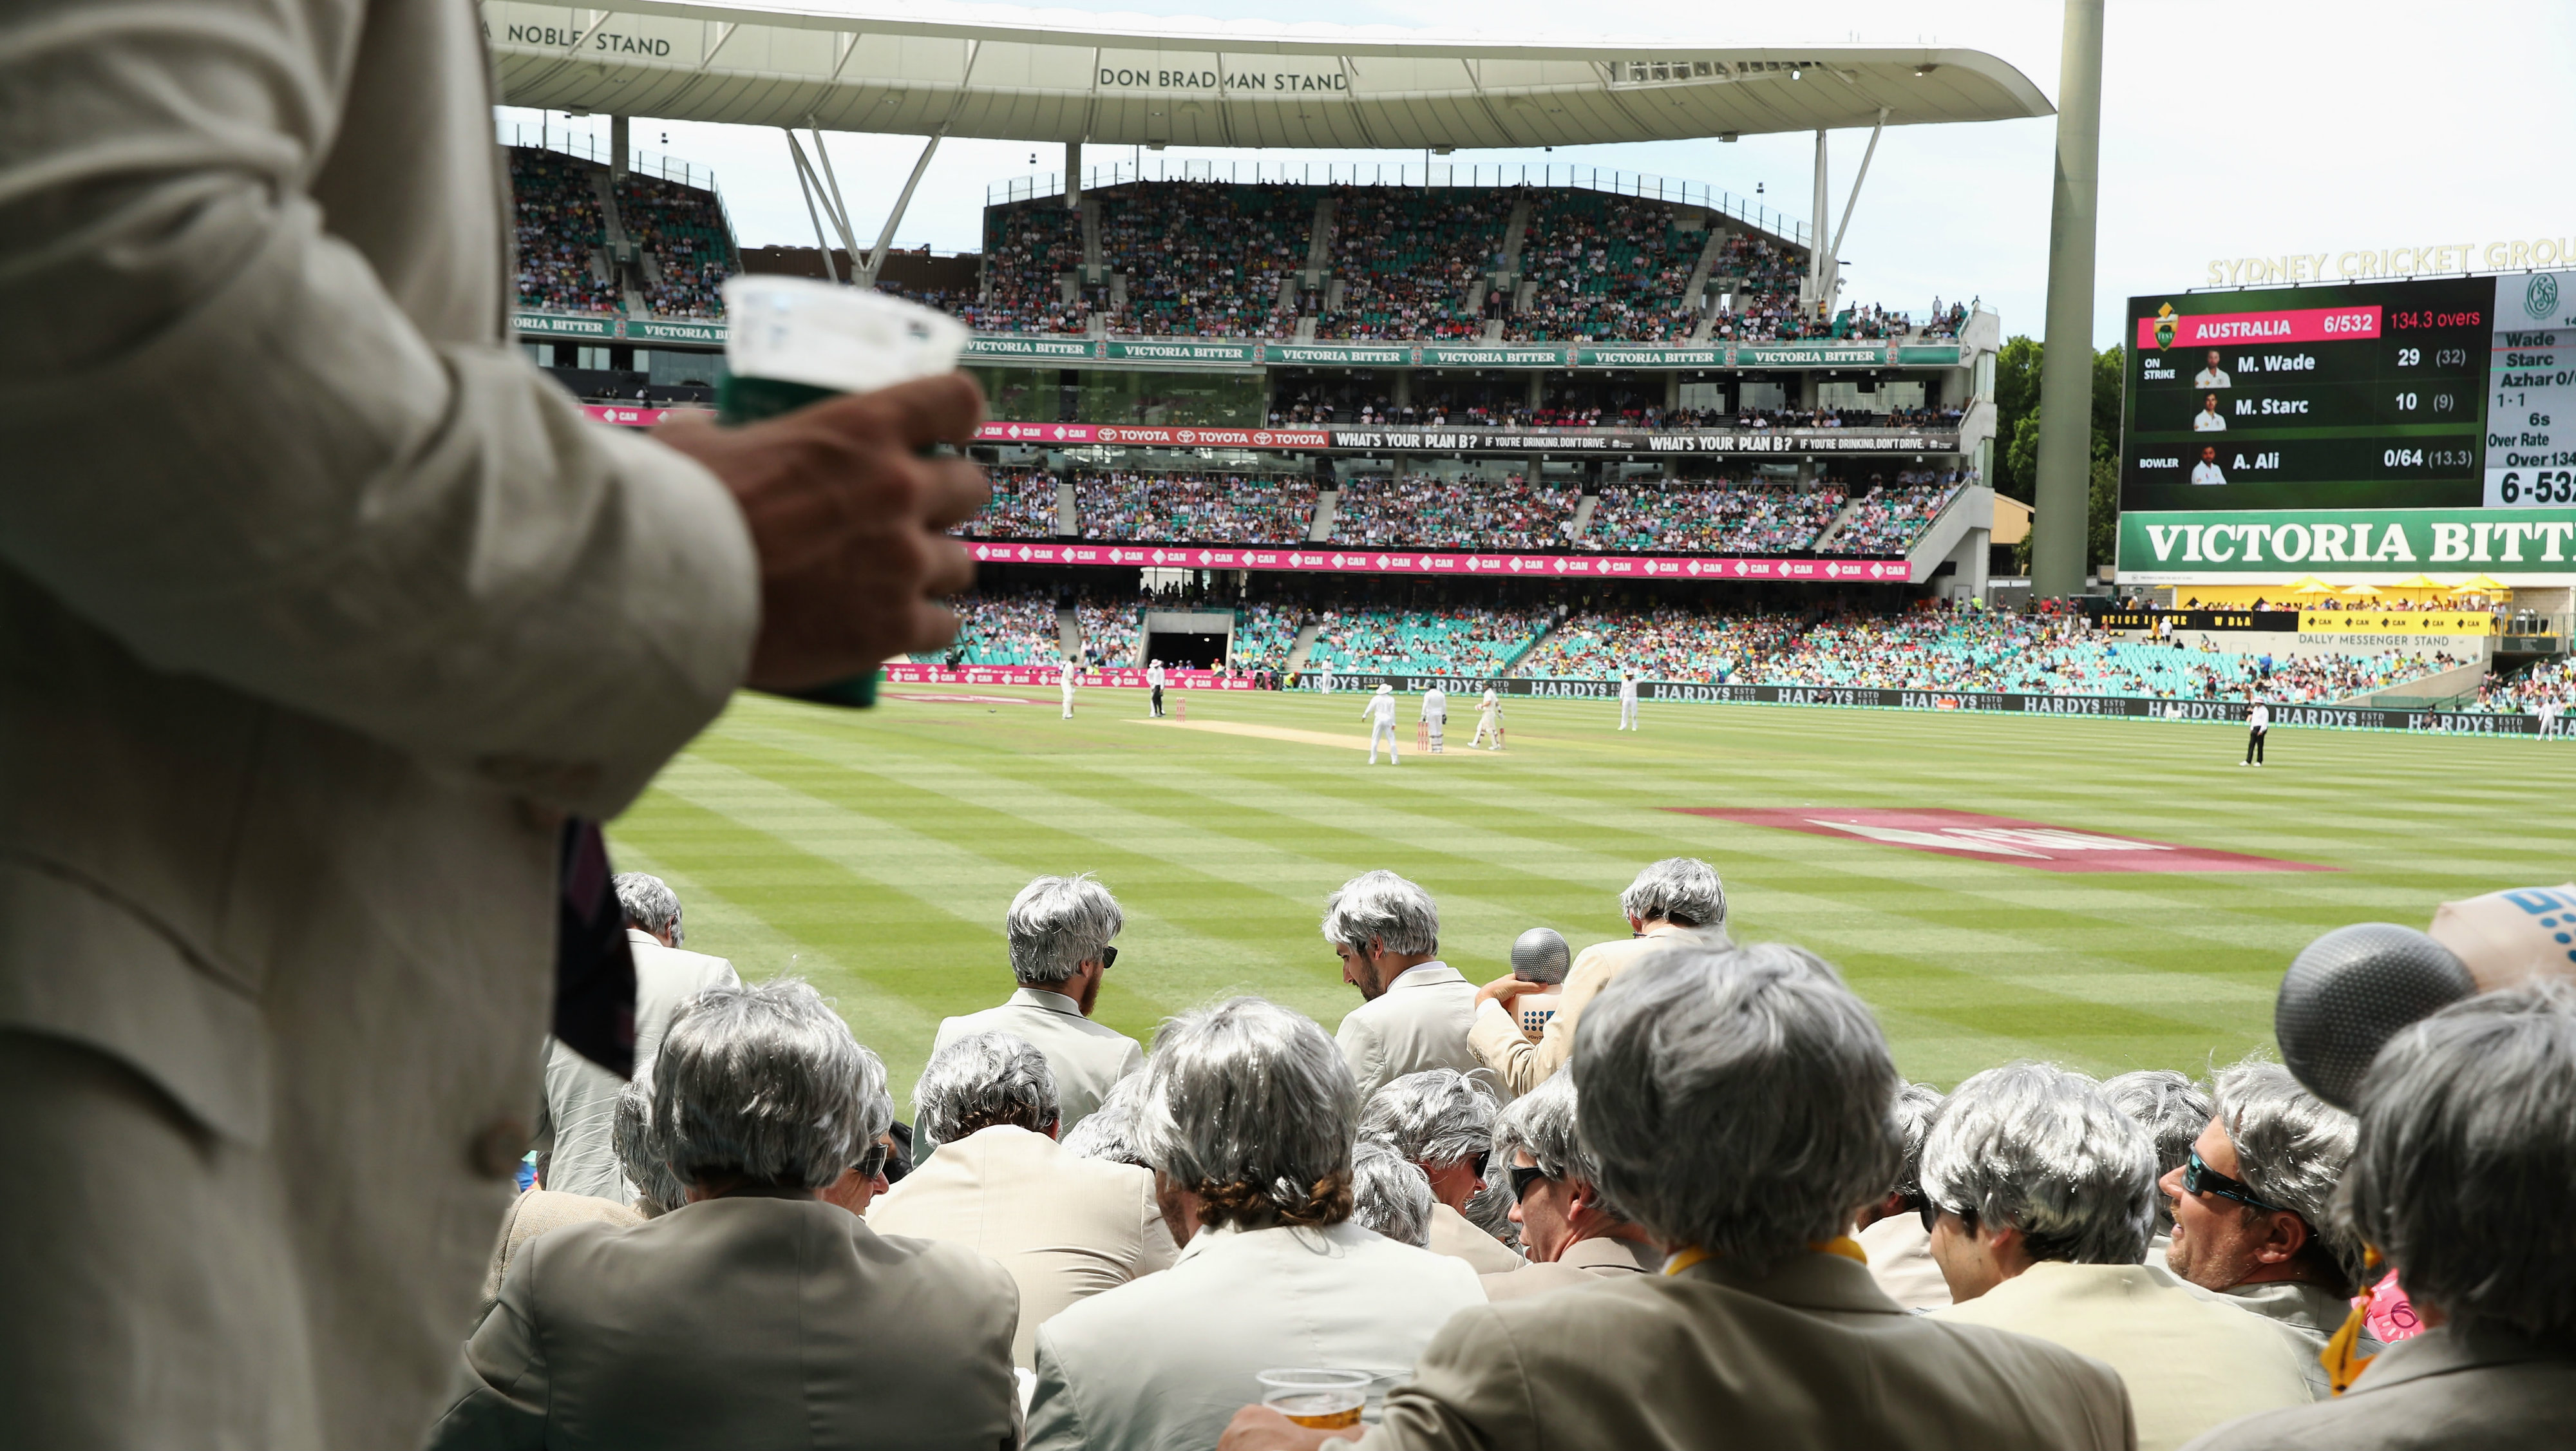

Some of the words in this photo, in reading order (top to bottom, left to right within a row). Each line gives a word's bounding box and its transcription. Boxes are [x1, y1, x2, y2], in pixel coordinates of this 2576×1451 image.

[509, 24, 583, 48] NOBLE
[596, 33, 670, 57] STAND
[1101, 68, 1150, 86] DON
[1160, 70, 1265, 90] BRADMAN
[1274, 73, 1347, 91] STAND
[2207, 253, 2328, 283] SYDNEY
[2337, 243, 2475, 276] CRICKET
[552, 319, 603, 333] BITTER
[2196, 320, 2291, 339] AUSTRALIA
[2324, 314, 2373, 332] 6/532
[2391, 310, 2433, 329] 134.3
[2438, 312, 2480, 327] overs
[644, 325, 712, 340] VICTORIA
[2506, 332, 2555, 347] Wade
[967, 341, 1032, 354] VICTORIA
[1035, 343, 1084, 355] BITTER
[1124, 345, 1191, 357] VICTORIA
[1194, 347, 1243, 359] BITTER
[1282, 350, 1348, 361] VICTORIA
[1351, 351, 1400, 362] BITTER
[1437, 352, 1503, 363] VICTORIA
[1506, 352, 1556, 363] BITTER
[1595, 352, 1662, 363] VICTORIA
[1665, 352, 1714, 363] BITTER
[1754, 352, 1822, 362] VICTORIA
[1824, 351, 1875, 361] BITTER
[2238, 356, 2259, 372] M.
[2264, 354, 2316, 372] Wade
[2398, 348, 2421, 366] 29
[2436, 348, 2466, 367] (32)
[2506, 352, 2554, 367] Starc
[2145, 358, 2160, 368] ON
[2144, 369, 2175, 380] STRIKE
[2501, 371, 2553, 388] Azhar
[2556, 370, 2576, 386] 0/
[2235, 399, 2257, 415] M.
[2261, 398, 2309, 415] Starc
[2396, 392, 2418, 411] 10
[2434, 394, 2454, 412] (9)
[619, 412, 638, 421] CAN
[2529, 412, 2551, 426] 6s
[985, 427, 1003, 435] CAN
[1023, 428, 1041, 437] CAN
[1068, 429, 1086, 438] CAN
[1119, 430, 1170, 441] TOYOTA
[1198, 432, 1248, 443] TOYOTA
[1275, 433, 1325, 445] TOYOTA
[1336, 432, 1381, 447] WHAT'S
[1385, 433, 1421, 448] YOUR
[1425, 433, 1455, 448] PLAN
[1459, 434, 1477, 448] B?
[1485, 437, 1493, 447] IF
[1495, 437, 1521, 447] YOU'RE
[1582, 438, 1607, 449] DRIVE.
[2488, 433, 2517, 447] Over
[2521, 432, 2550, 447] Rate
[1649, 436, 1695, 451] WHAT'S
[1699, 437, 1734, 451] YOUR
[1739, 437, 1770, 451] PLAN
[1773, 437, 1793, 451] B?
[1800, 439, 1808, 449] IF
[1810, 439, 1837, 449] YOU'RE
[1900, 439, 1925, 450] DRIVE.
[2139, 458, 2179, 468] BOWLER
[2233, 453, 2251, 469] A.
[2255, 452, 2280, 469] Ali
[2383, 448, 2423, 468] 0/64
[2428, 450, 2473, 469] (13.3)
[2506, 452, 2548, 467] Over
[2145, 522, 2417, 564] VICTORIA
[2429, 522, 2576, 562] BITT
[992, 549, 1010, 558] CAN
[1034, 549, 1053, 559] CAN
[1077, 551, 1096, 560] CAN
[1124, 551, 1144, 561] CAN
[1168, 553, 1186, 562] CAN
[1214, 554, 1233, 563] CAN
[1257, 555, 1276, 564] CAN
[1304, 556, 1323, 565] CAN
[1347, 556, 1366, 566] CAN
[1392, 558, 1411, 567] CAN
[1435, 558, 1454, 568] CAN
[1482, 559, 1501, 569] CAN
[1524, 560, 1544, 569] CAN
[1569, 562, 1589, 571] CAN
[1612, 562, 1631, 571] CAN
[1660, 563, 1679, 573] CAN
[1703, 564, 1722, 573] CAN
[1750, 564, 1770, 573] CAN
[1794, 565, 1813, 574] CAN
[1841, 565, 1861, 574] CAN
[1886, 565, 1906, 575] CAN
[2299, 634, 2334, 645] DALLY
[2340, 635, 2408, 645] MESSENGER
[2414, 636, 2449, 646] STAND
[1531, 681, 1607, 697] HARDYS
[1654, 685, 1730, 701] HARDYS
[1981, 695, 2002, 703] ESTD
[2024, 697, 2099, 714] HARDYS
[2103, 699, 2125, 707] ESTD
[2275, 708, 2357, 726] HARDYS
[2361, 712, 2384, 720] ESTD
[2499, 717, 2523, 725] ESTD
